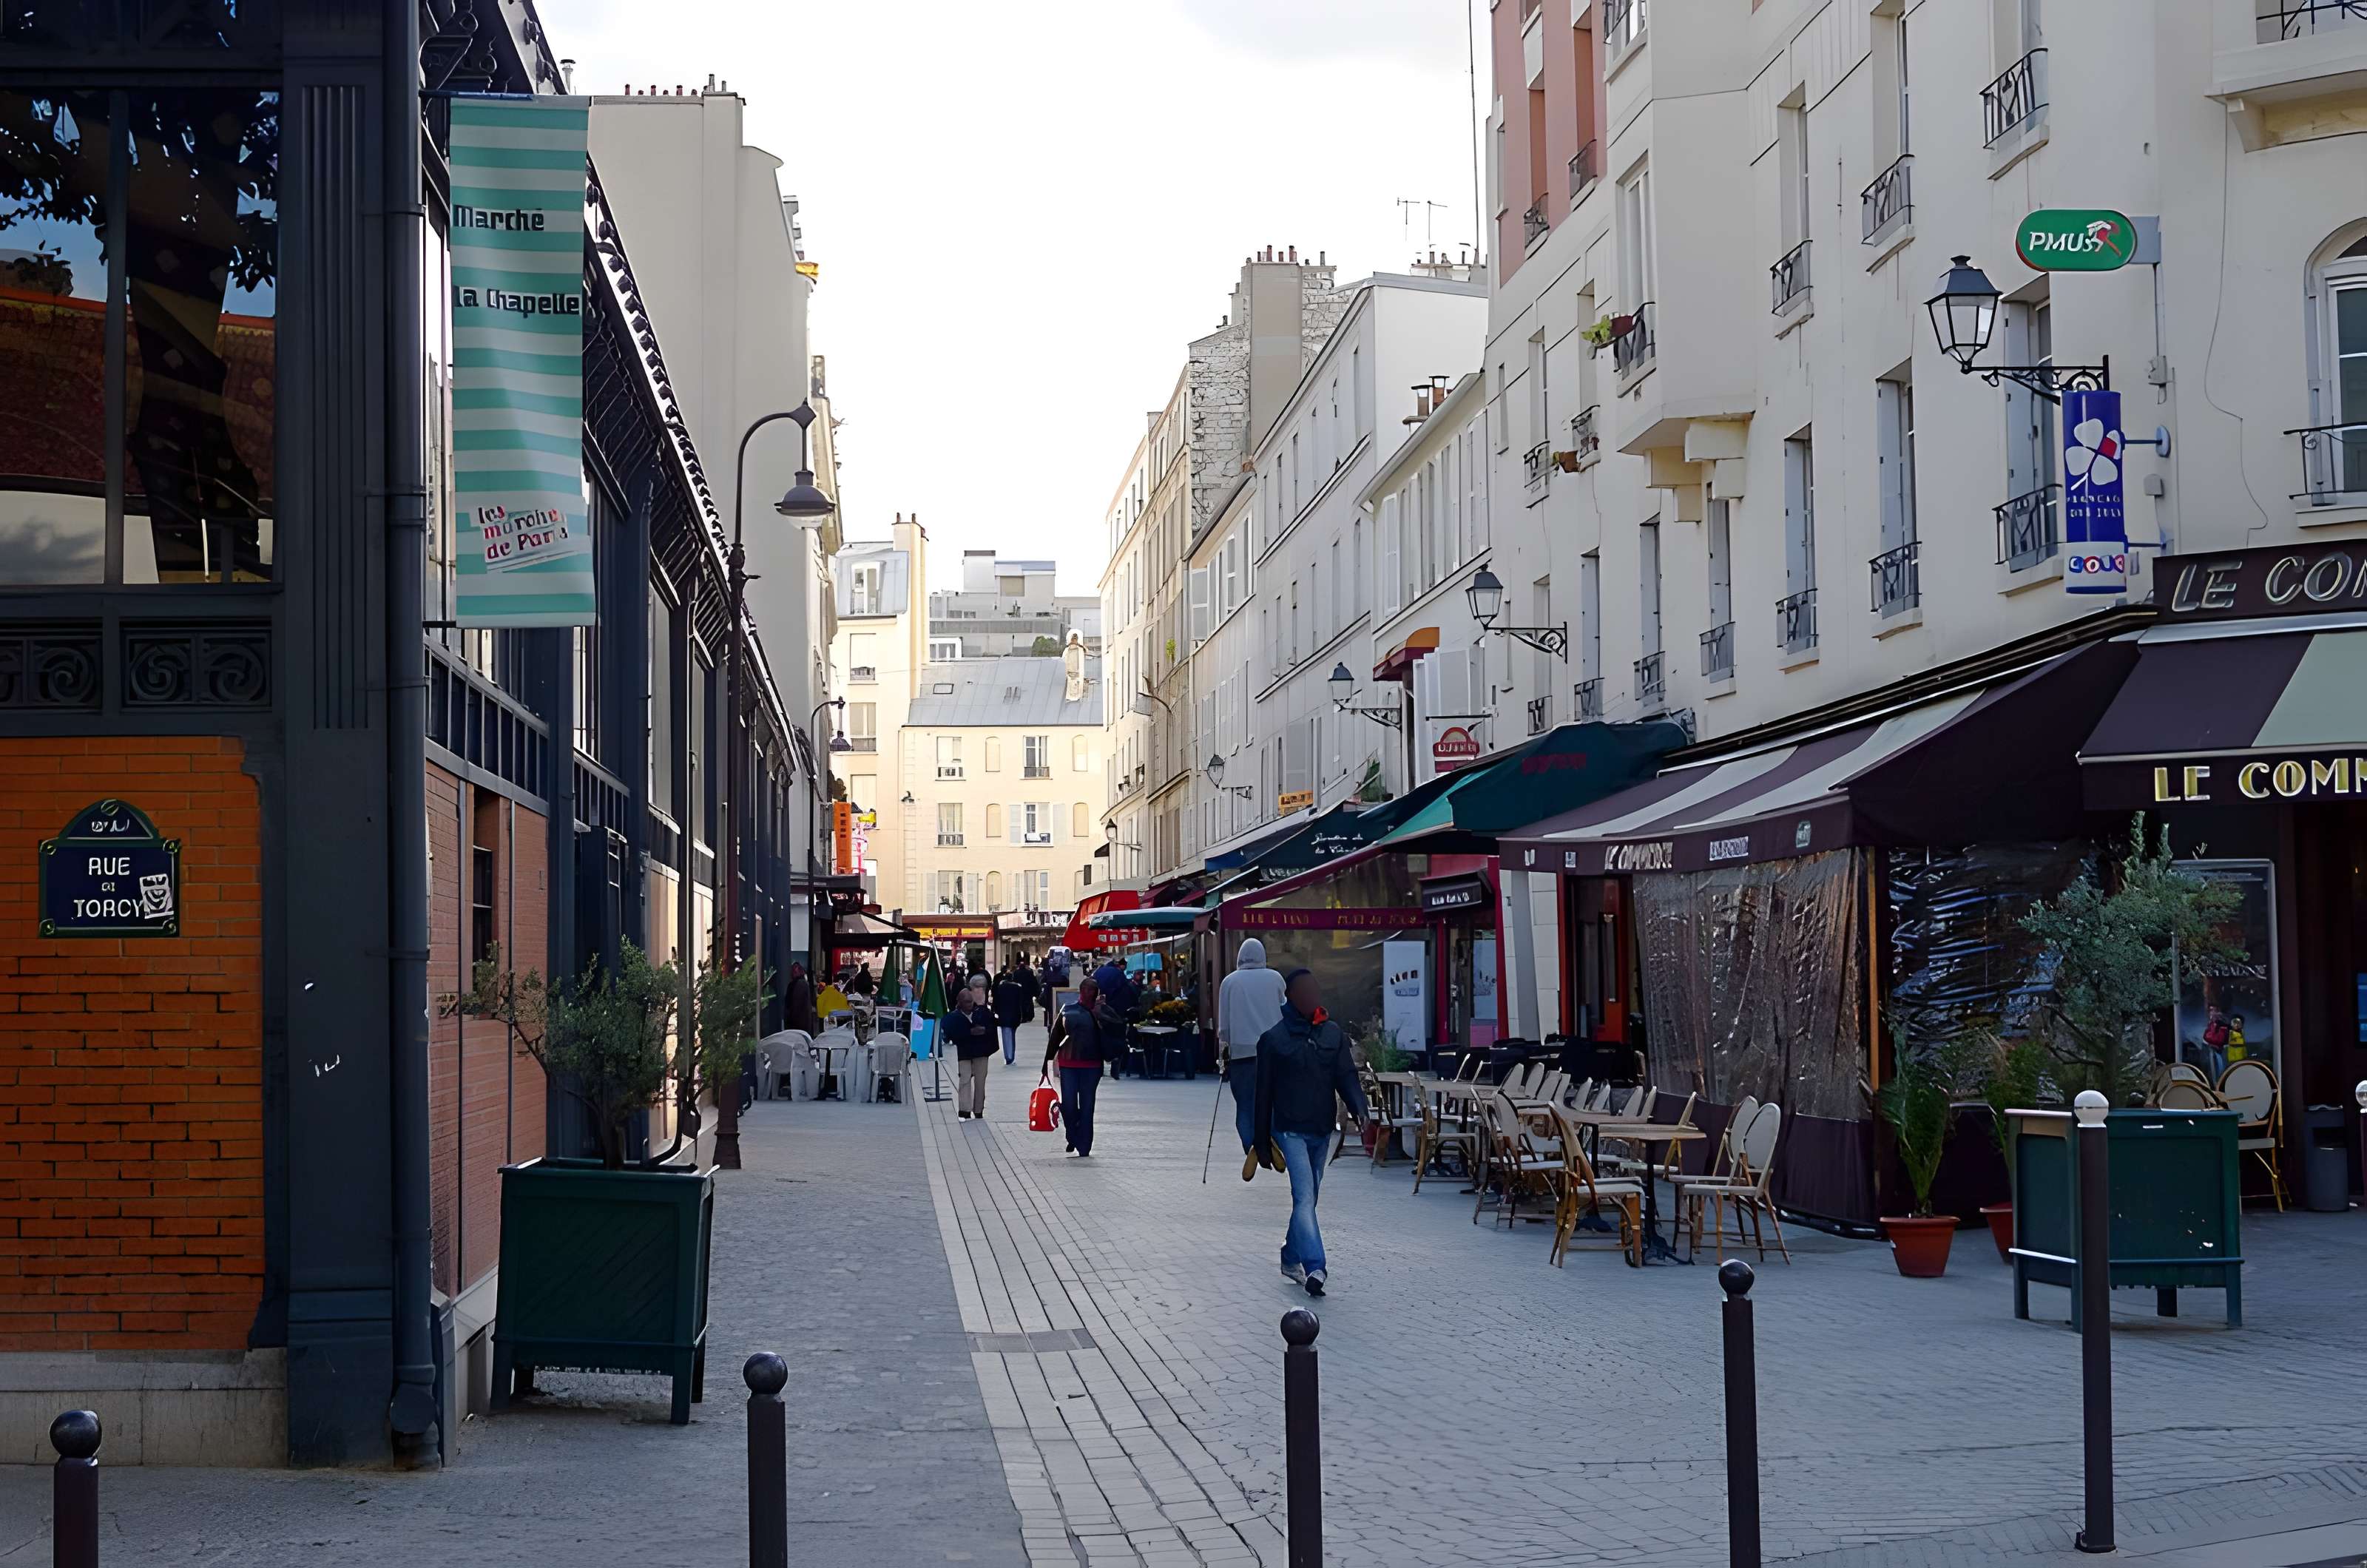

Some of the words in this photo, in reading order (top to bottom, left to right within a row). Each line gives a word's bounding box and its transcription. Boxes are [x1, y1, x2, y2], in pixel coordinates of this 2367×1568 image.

[486, 288, 580, 319] Chapelle
[2171, 560, 2243, 612] LE
[2154, 765, 2211, 802] LE
[88, 856, 131, 876] RUE
[73, 898, 144, 918] TORCY
